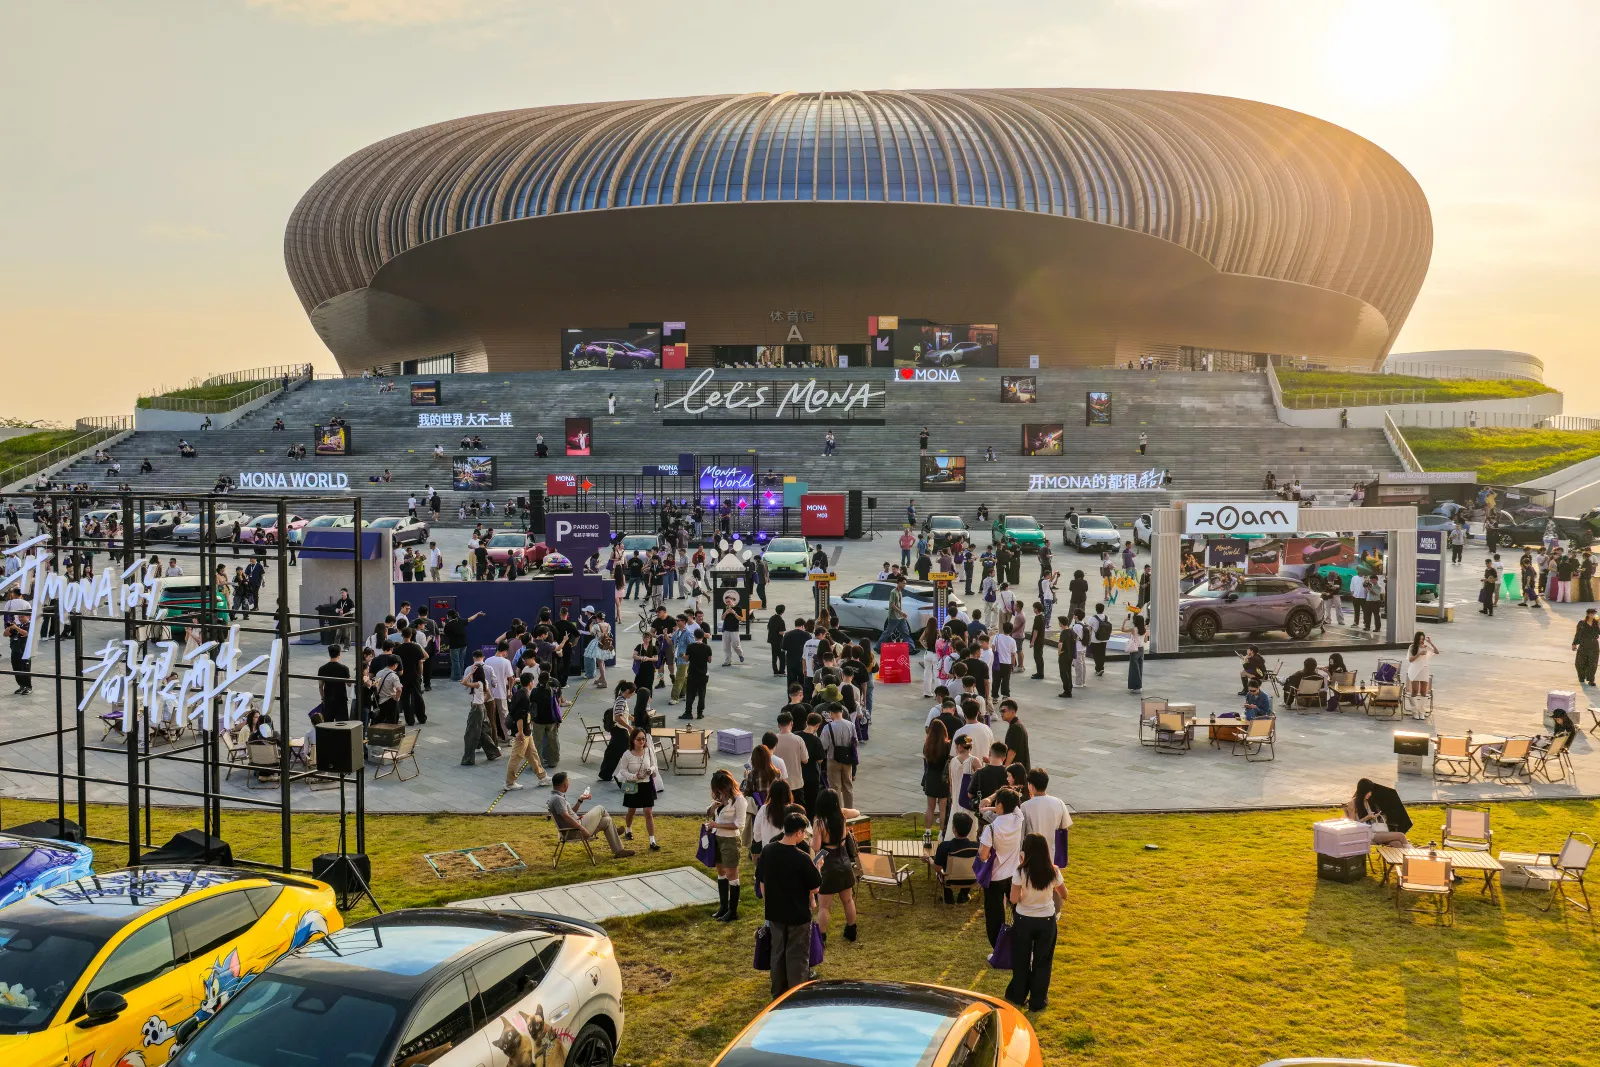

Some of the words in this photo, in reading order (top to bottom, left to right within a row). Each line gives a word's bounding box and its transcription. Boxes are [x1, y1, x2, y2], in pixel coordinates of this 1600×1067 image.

[769, 310, 814, 323] 体育馆
[786, 324, 804, 342] A
[915, 369, 960, 381] MONA
[239, 472, 288, 488] MONA
[289, 472, 348, 488] WORLD
[556, 520, 572, 542] P
